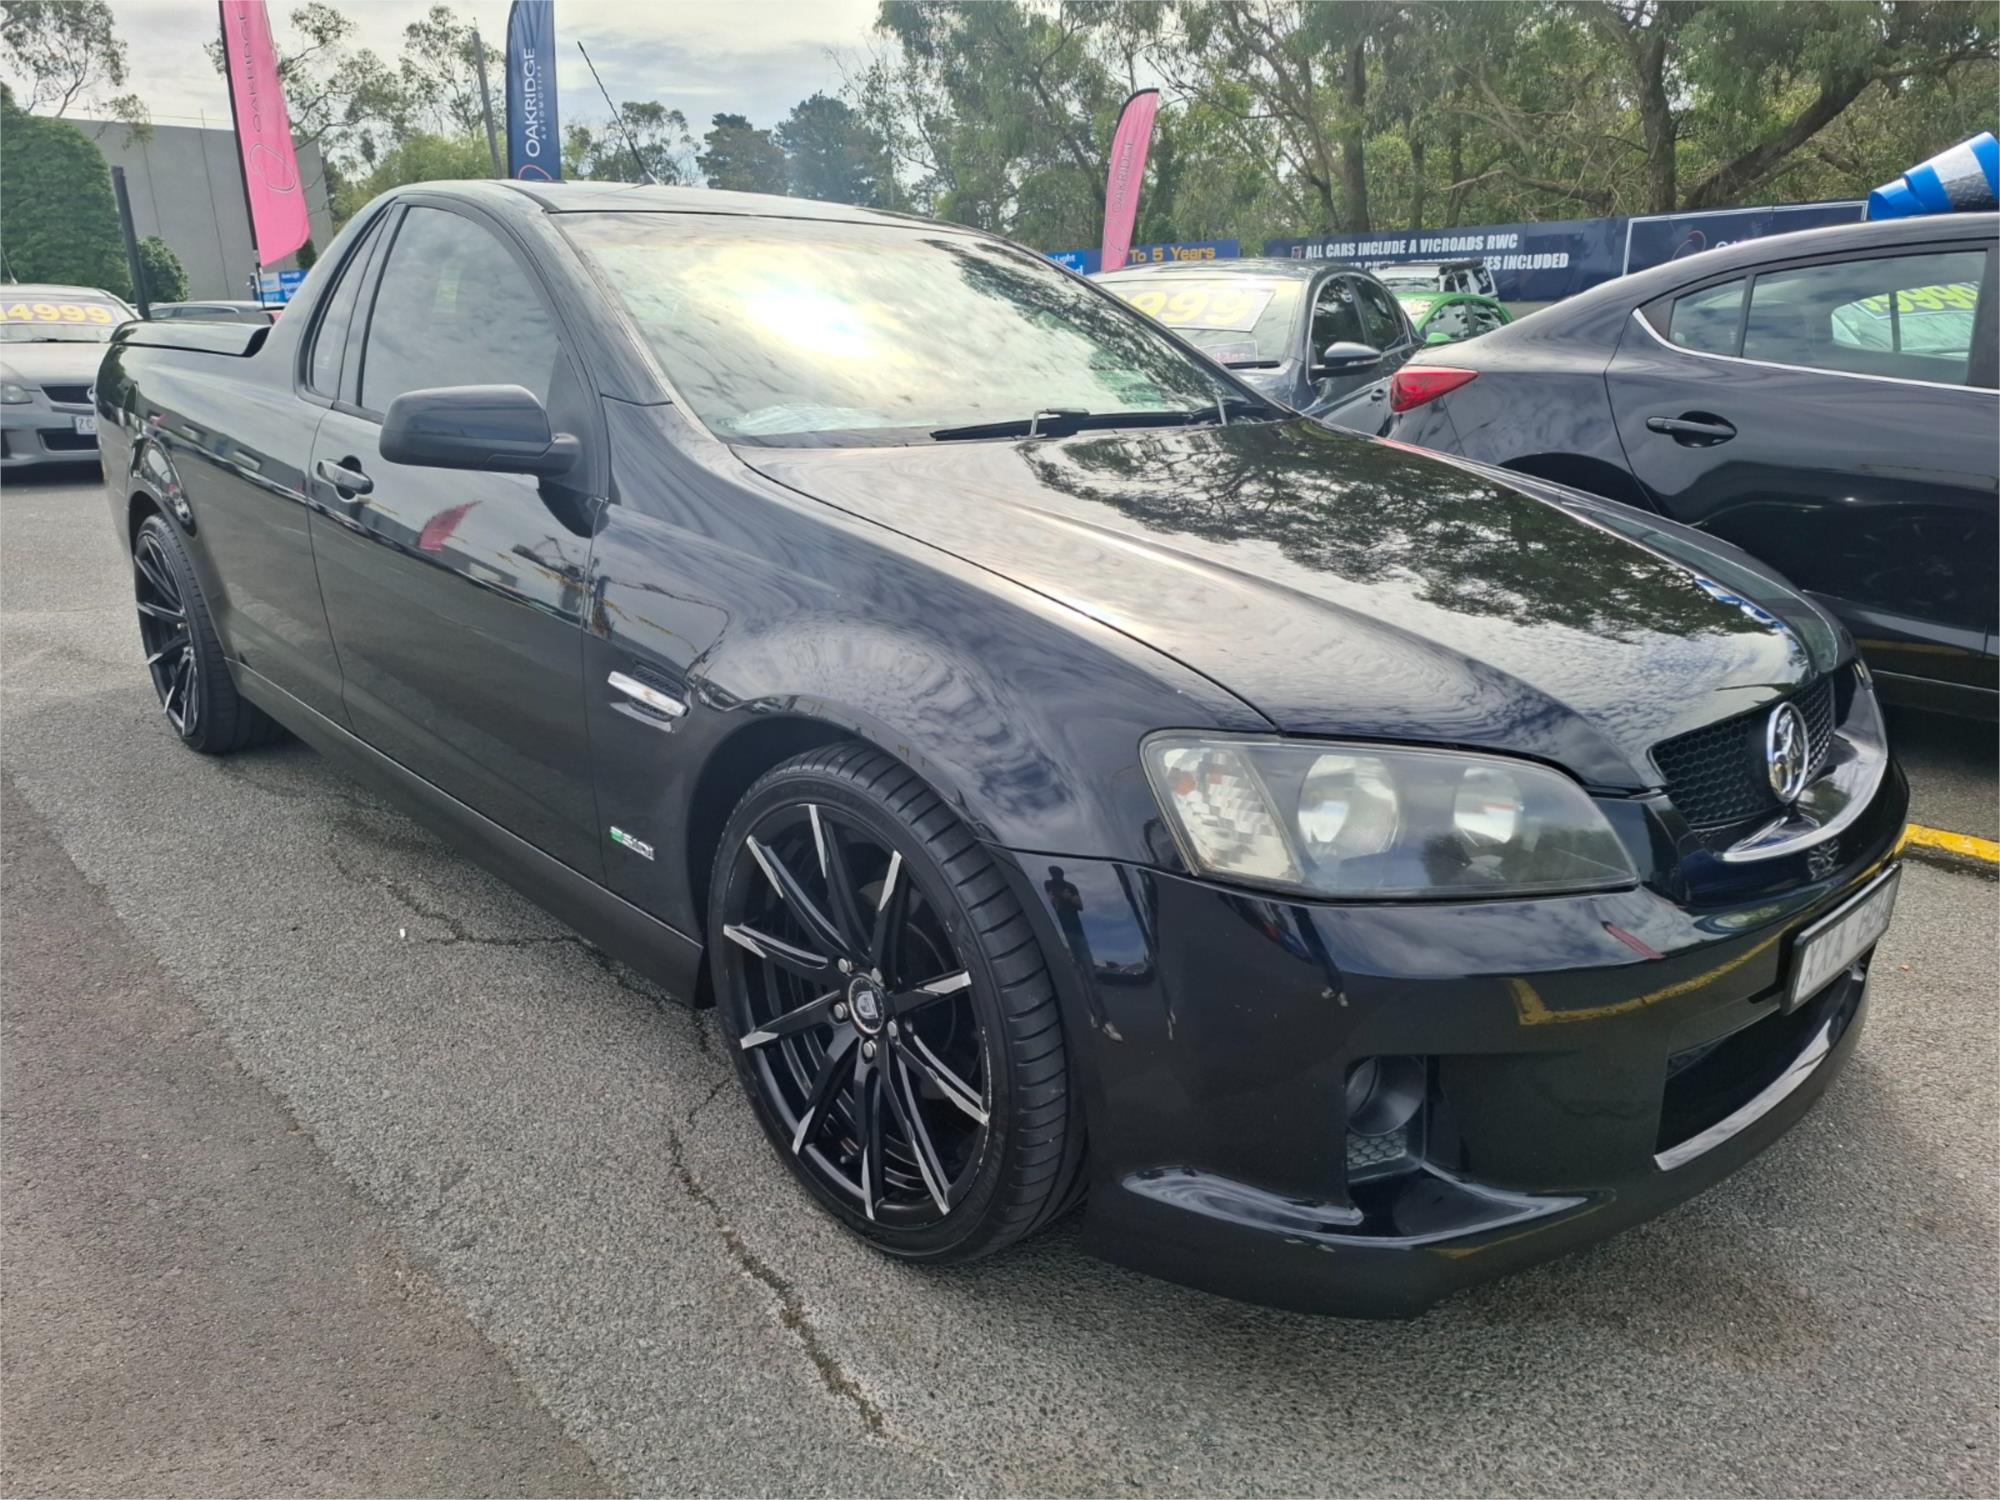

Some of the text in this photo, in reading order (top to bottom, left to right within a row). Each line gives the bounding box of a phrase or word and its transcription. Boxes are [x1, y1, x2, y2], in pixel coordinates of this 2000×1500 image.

[523, 48, 541, 157] OAKRIDGE
[1130, 246, 1215, 263] To 5 Years
[1305, 233, 1519, 259] ALL CARS INCLUDE A VICROADS RWC
[1502, 253, 1569, 270] INCLUDED
